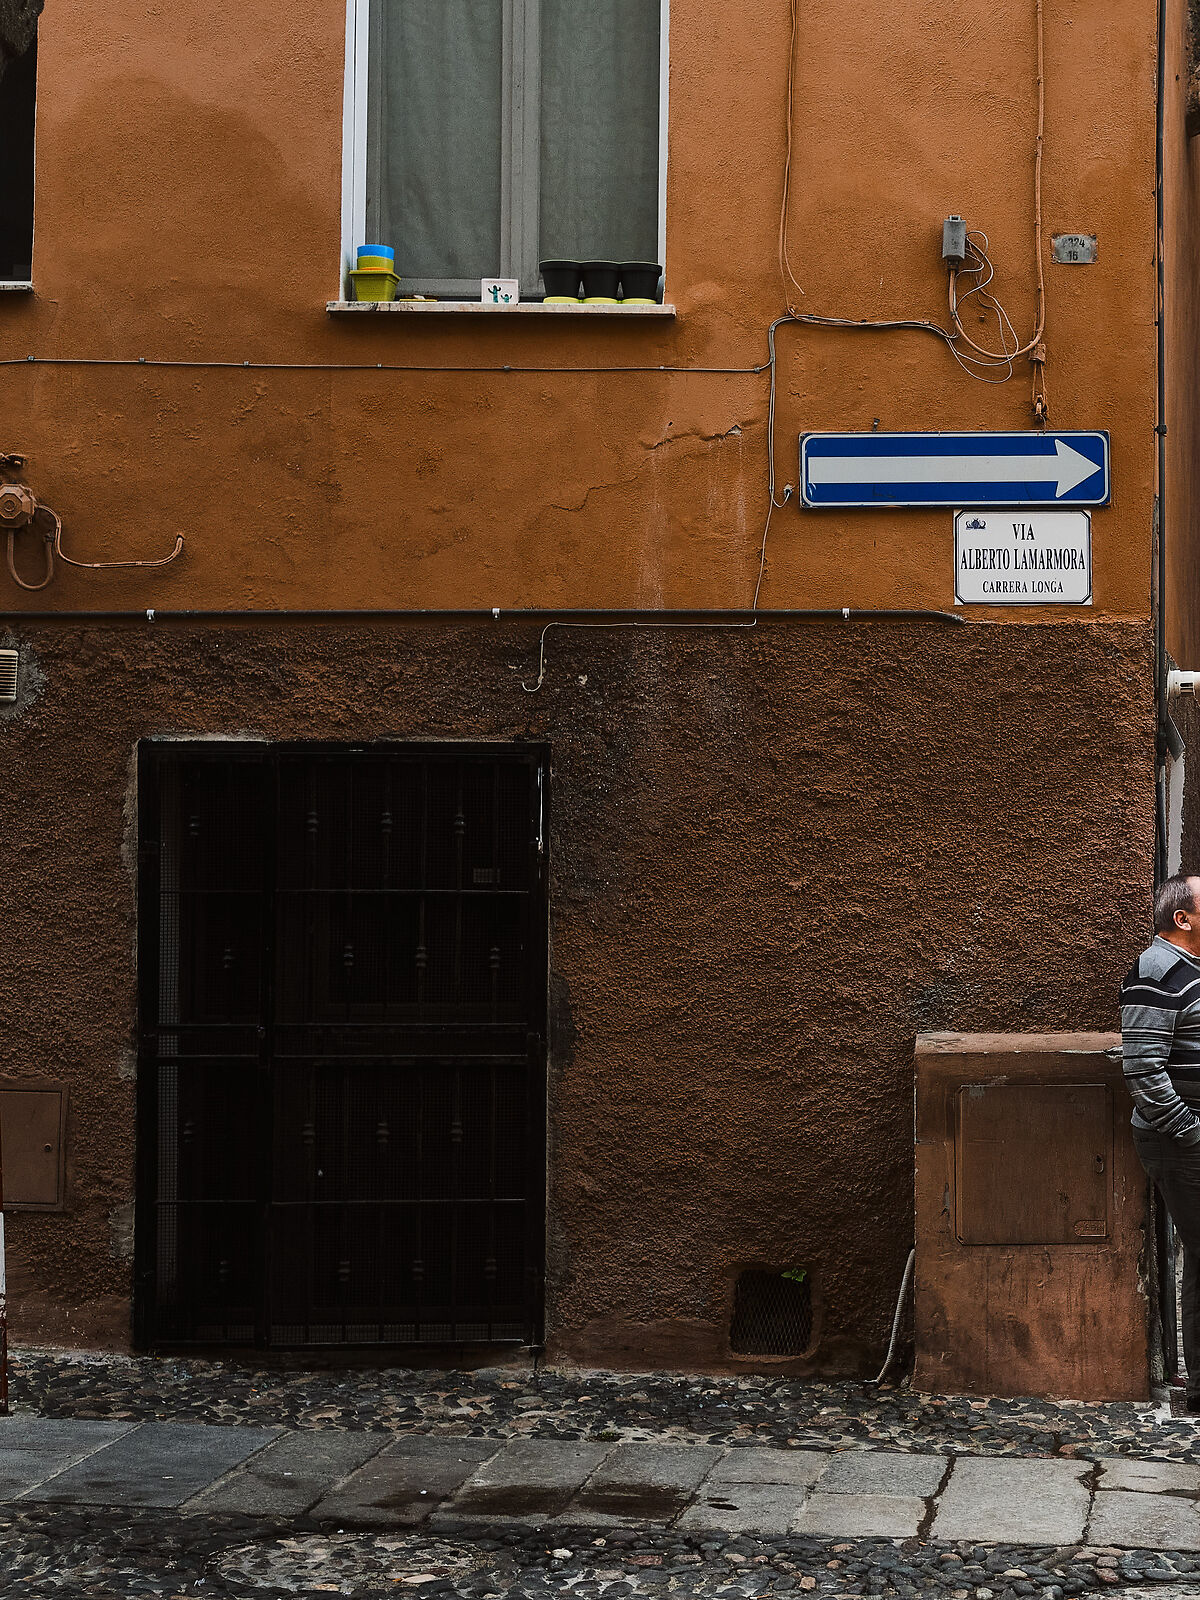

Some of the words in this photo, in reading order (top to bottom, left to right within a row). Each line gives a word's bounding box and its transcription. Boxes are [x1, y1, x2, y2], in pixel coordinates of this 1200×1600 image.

[1012, 523, 1035, 541] VIA
[960, 548, 1010, 570] ALBERTO
[1013, 548, 1086, 570] LAMARMORA
[982, 580, 1028, 593] CARRERA
[1031, 580, 1064, 593] LONGA
